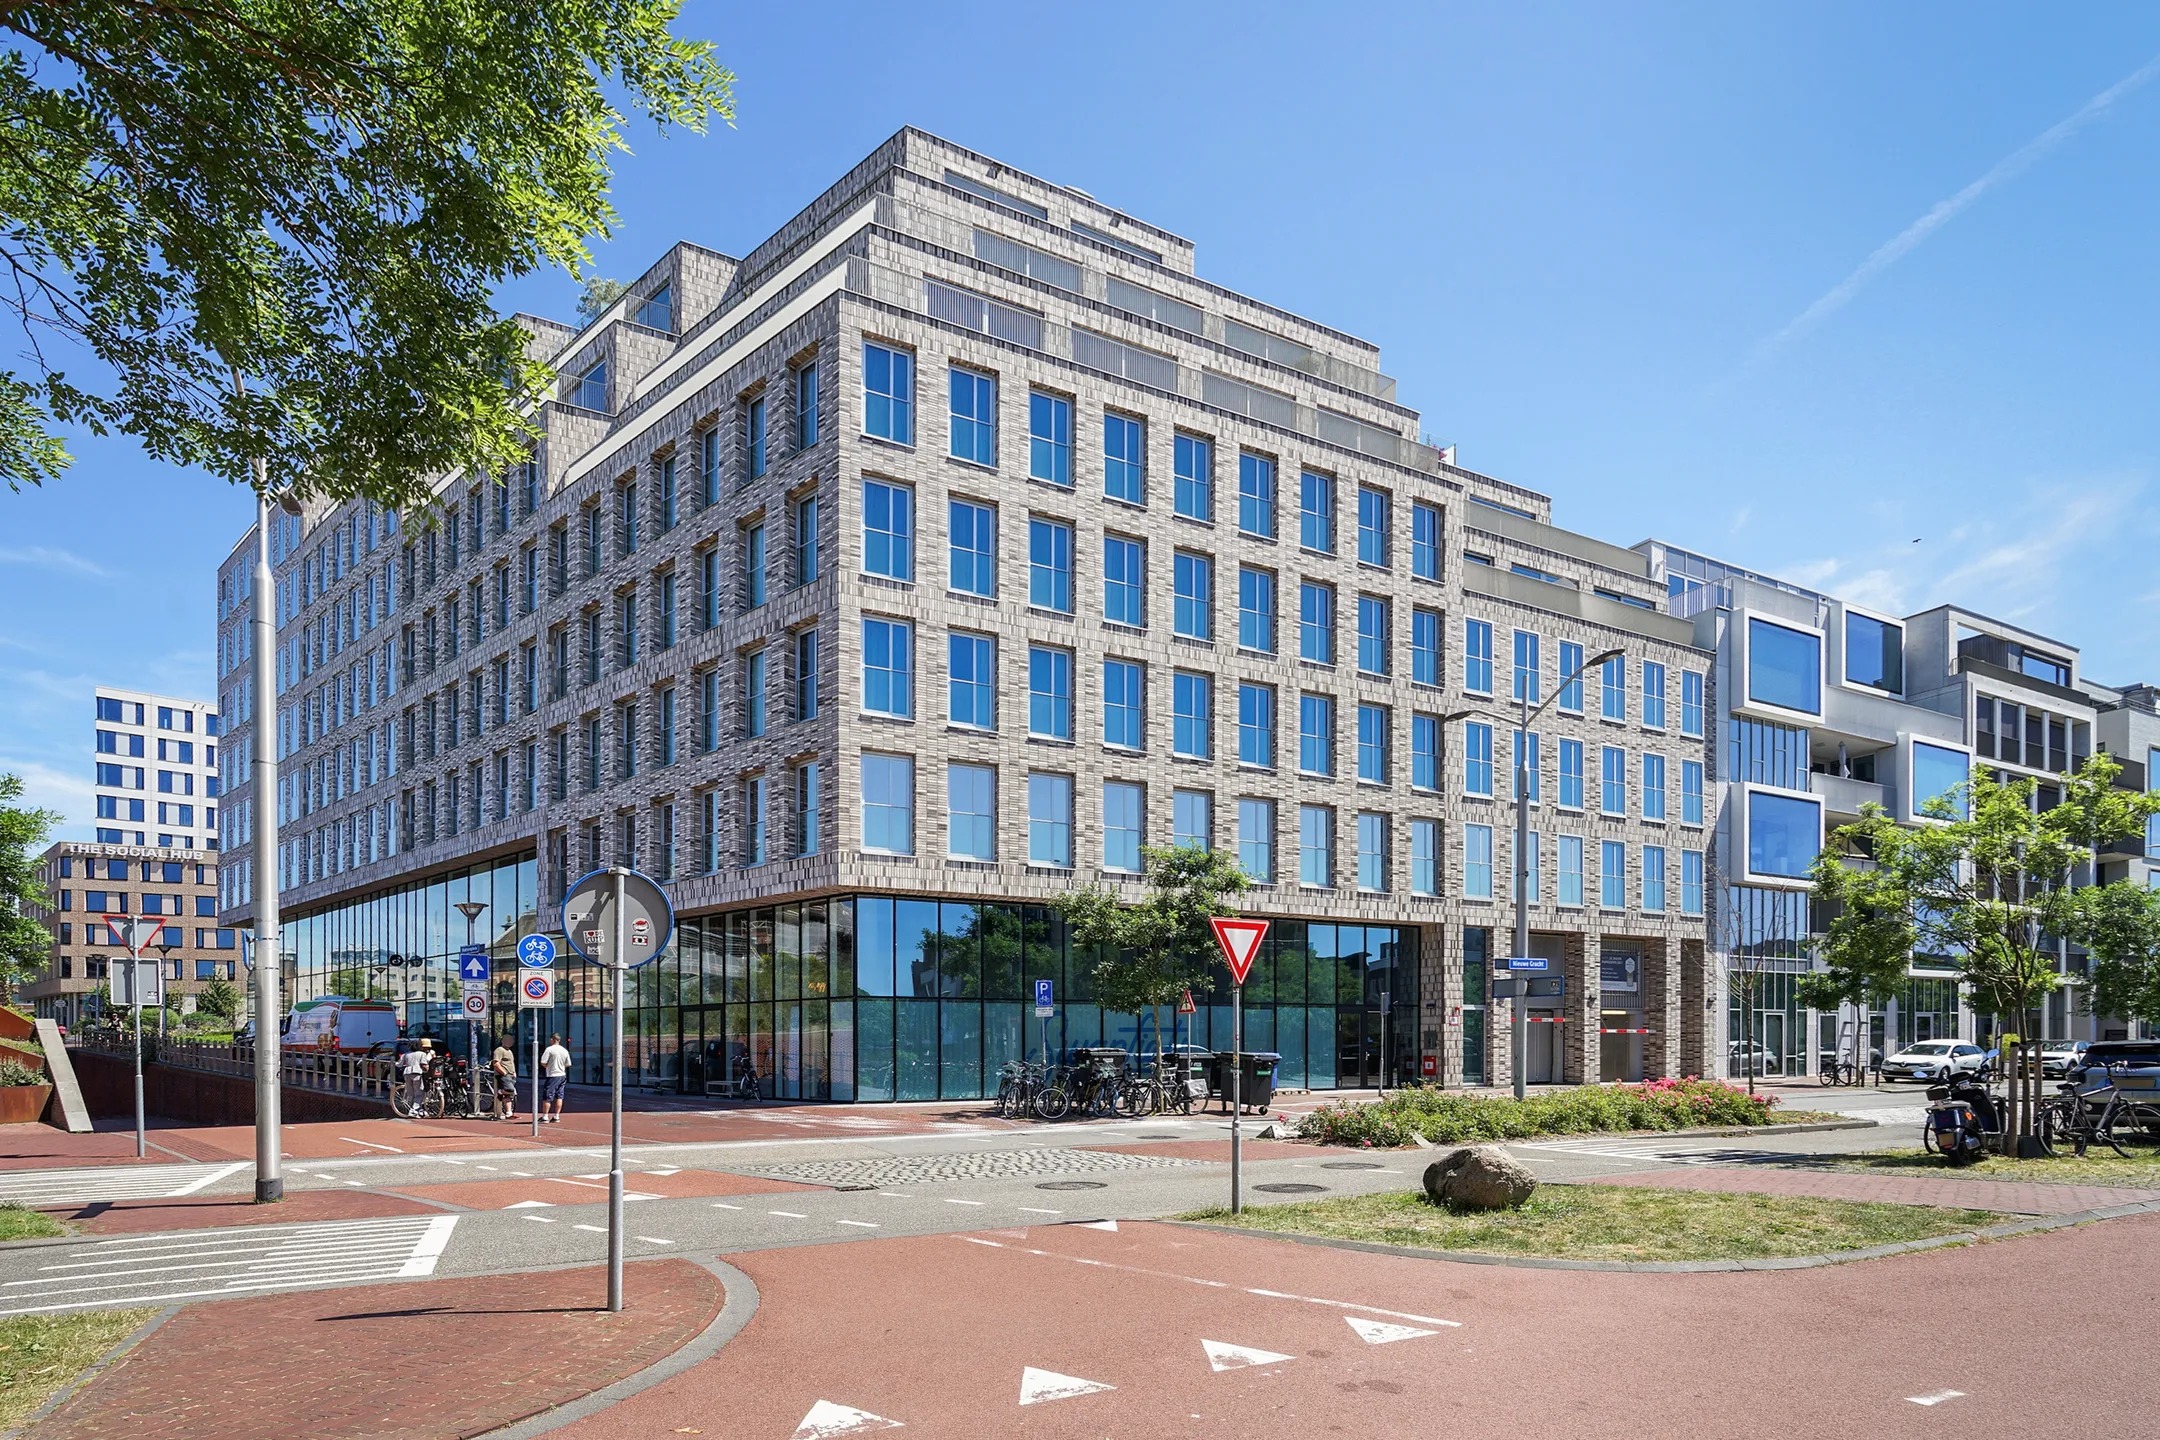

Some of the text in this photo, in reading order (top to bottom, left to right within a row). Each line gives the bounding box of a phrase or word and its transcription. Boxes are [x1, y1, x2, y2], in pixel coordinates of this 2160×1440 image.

[67, 844, 204, 860] THE SOCIAL HUB
[1040, 982, 1049, 995] P
[470, 1000, 482, 1008] 30
